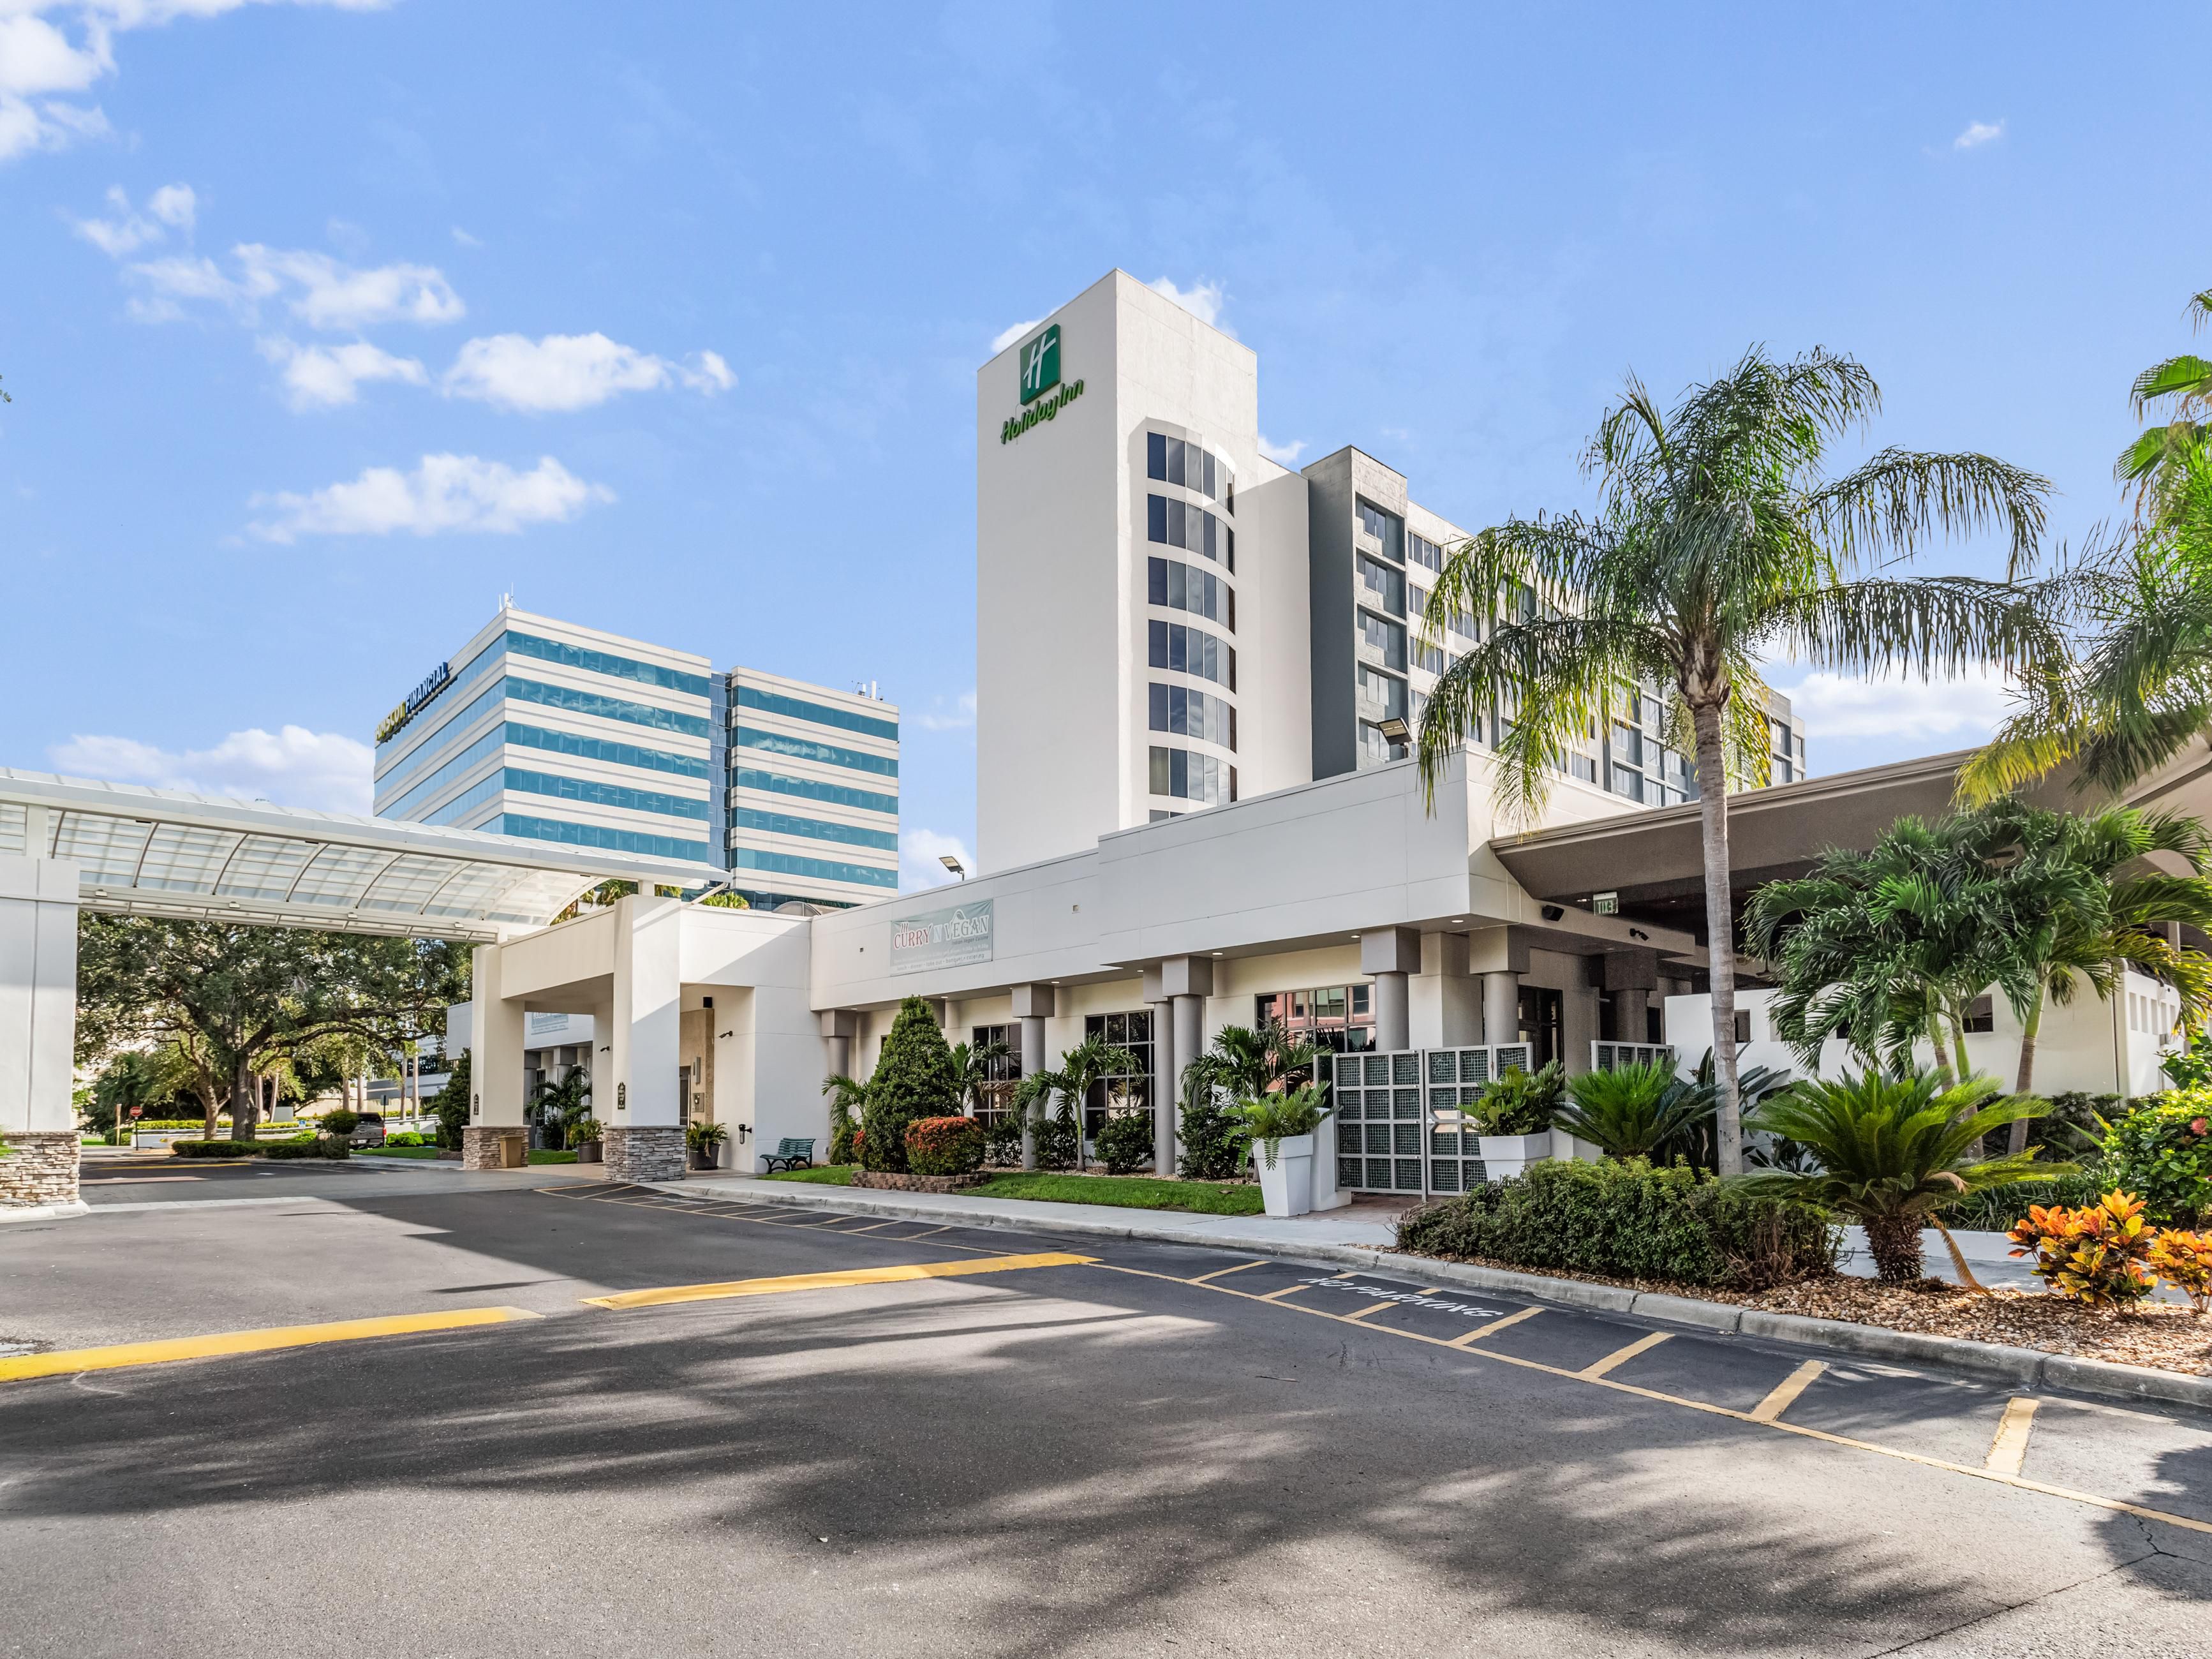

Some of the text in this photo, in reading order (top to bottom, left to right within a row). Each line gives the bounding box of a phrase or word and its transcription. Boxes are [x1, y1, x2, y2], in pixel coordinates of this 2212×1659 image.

[1000, 379, 1084, 445] Holiday Inn
[406, 662, 450, 714] FINANCIAL
[894, 923, 933, 950] CURRY
[944, 914, 990, 941] VEGAN
[1297, 1277, 1504, 1317] NO PARKING
